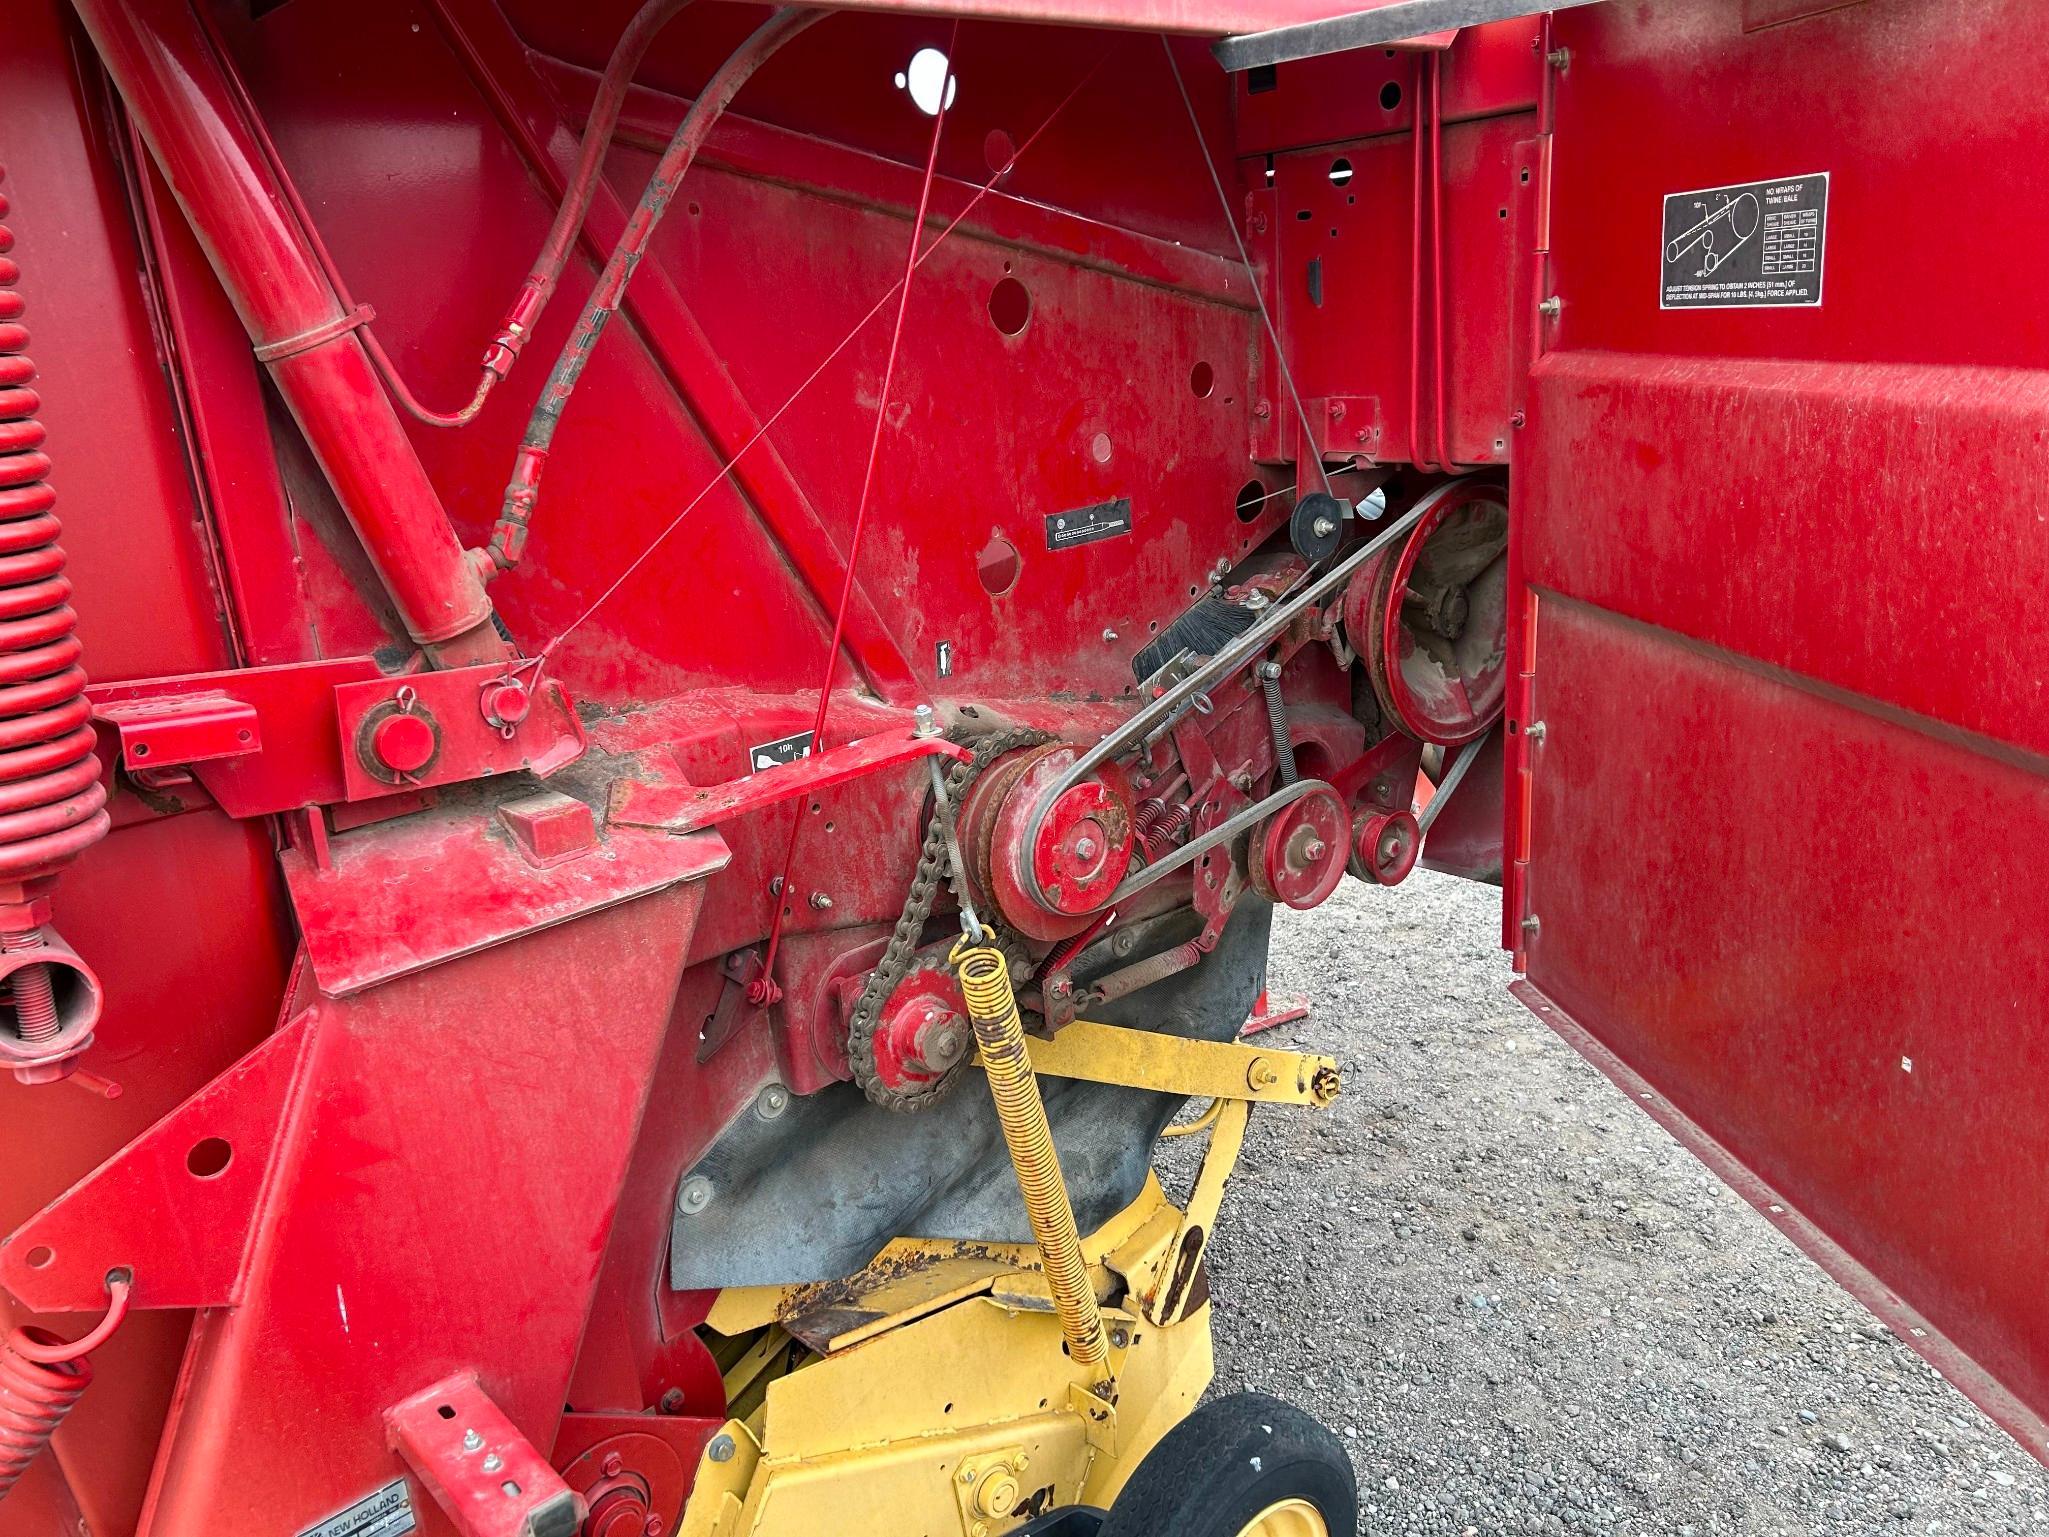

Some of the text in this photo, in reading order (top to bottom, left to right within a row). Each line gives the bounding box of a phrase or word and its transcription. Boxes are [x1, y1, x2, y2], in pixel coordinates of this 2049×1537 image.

[1776, 185, 1795, 195] WRAPS
[1795, 184, 1804, 192] OF
[1683, 284, 1702, 292] TENSION
[1702, 283, 1719, 291] SPRING
[1726, 282, 1743, 290] OBTAIN
[1748, 281, 1766, 289] INCHES
[1665, 293, 1693, 301] DEFLECTION
[1698, 291, 1720, 299] MID-SPAN
[1720, 291, 1731, 299] FOR
[1767, 289, 1785, 297] FORCE
[1785, 288, 1808, 297] APPLIED.
[778, 743, 793, 754] 10h
[328, 1519, 351, 1537] NEW
[352, 1493, 400, 1526] HOLLAND
